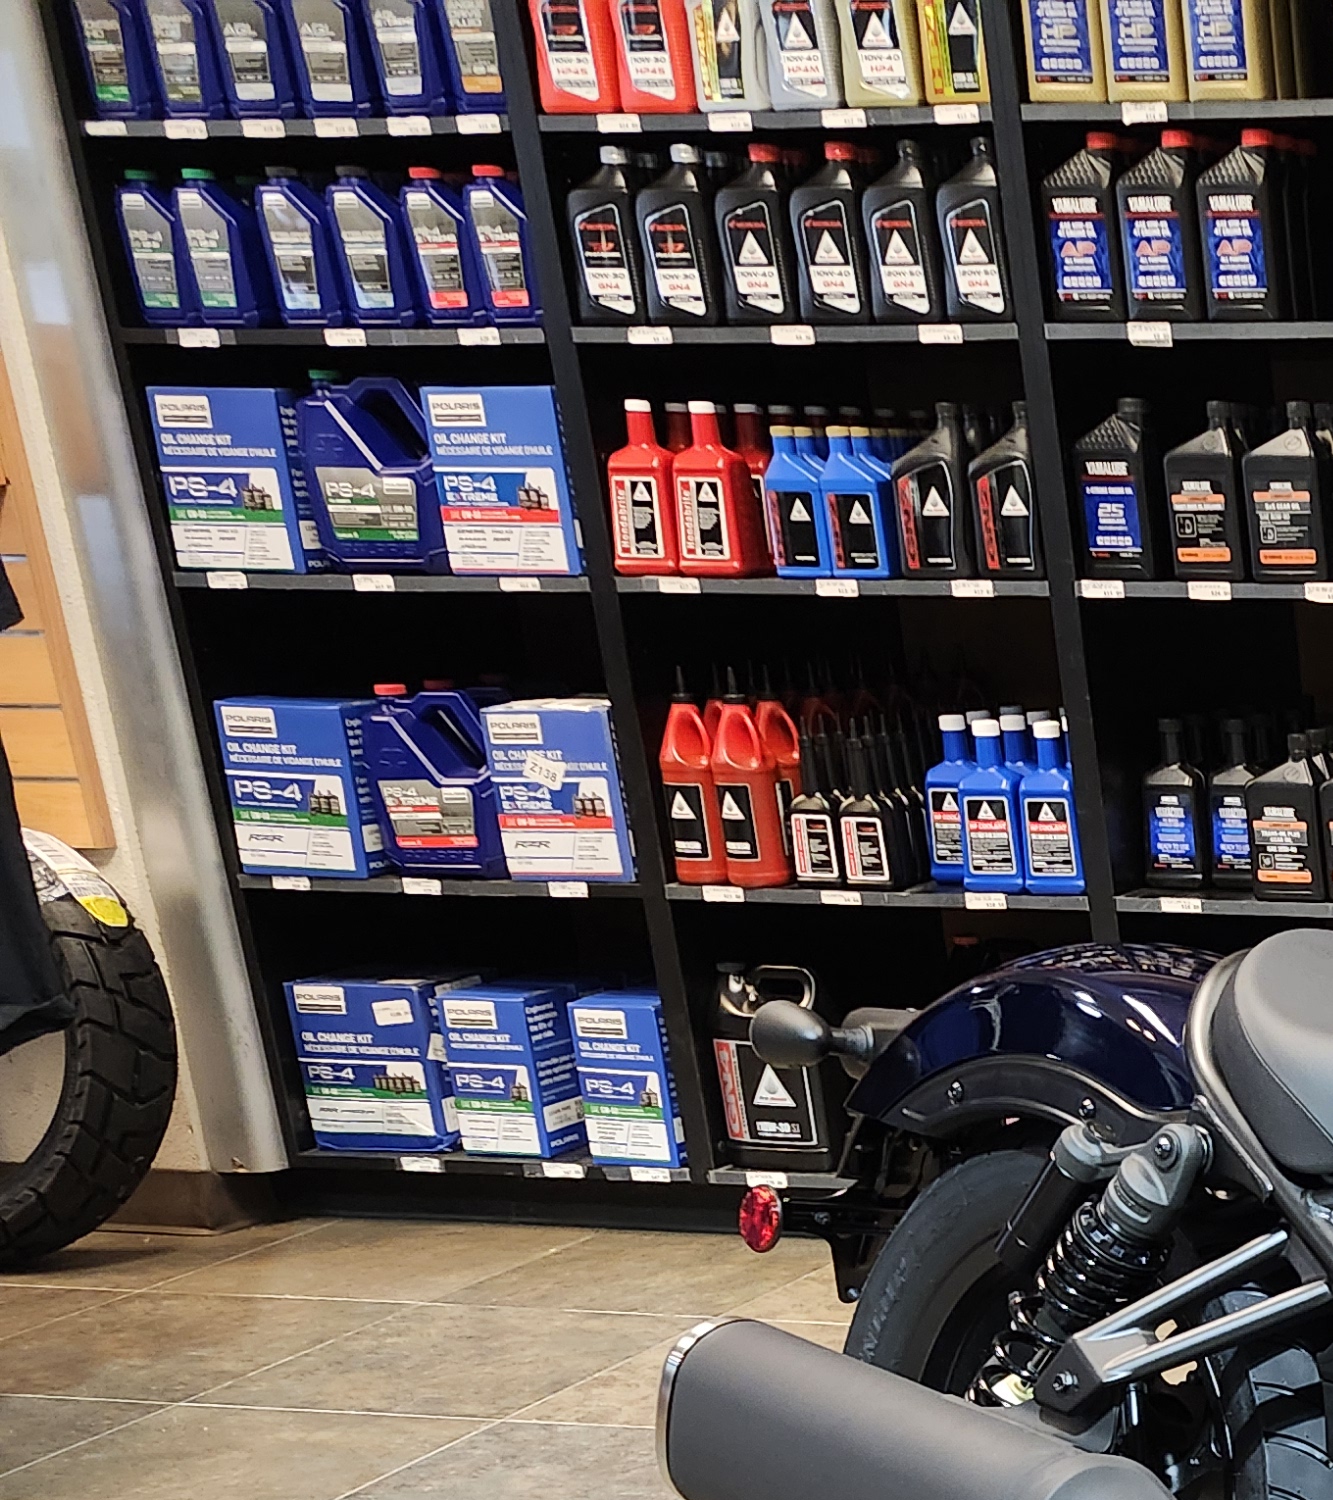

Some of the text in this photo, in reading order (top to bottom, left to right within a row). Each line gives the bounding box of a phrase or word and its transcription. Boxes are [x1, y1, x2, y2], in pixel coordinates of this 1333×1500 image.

[168, 476, 238, 498] PS-4
[443, 475, 496, 491] PS-4
[617, 488, 631, 549] Hondabrite
[682, 489, 697, 550] Hondabrite
[529, 761, 558, 783] Z138
[234, 779, 303, 802] PS-4
[585, 1078, 636, 1095] PS-4
